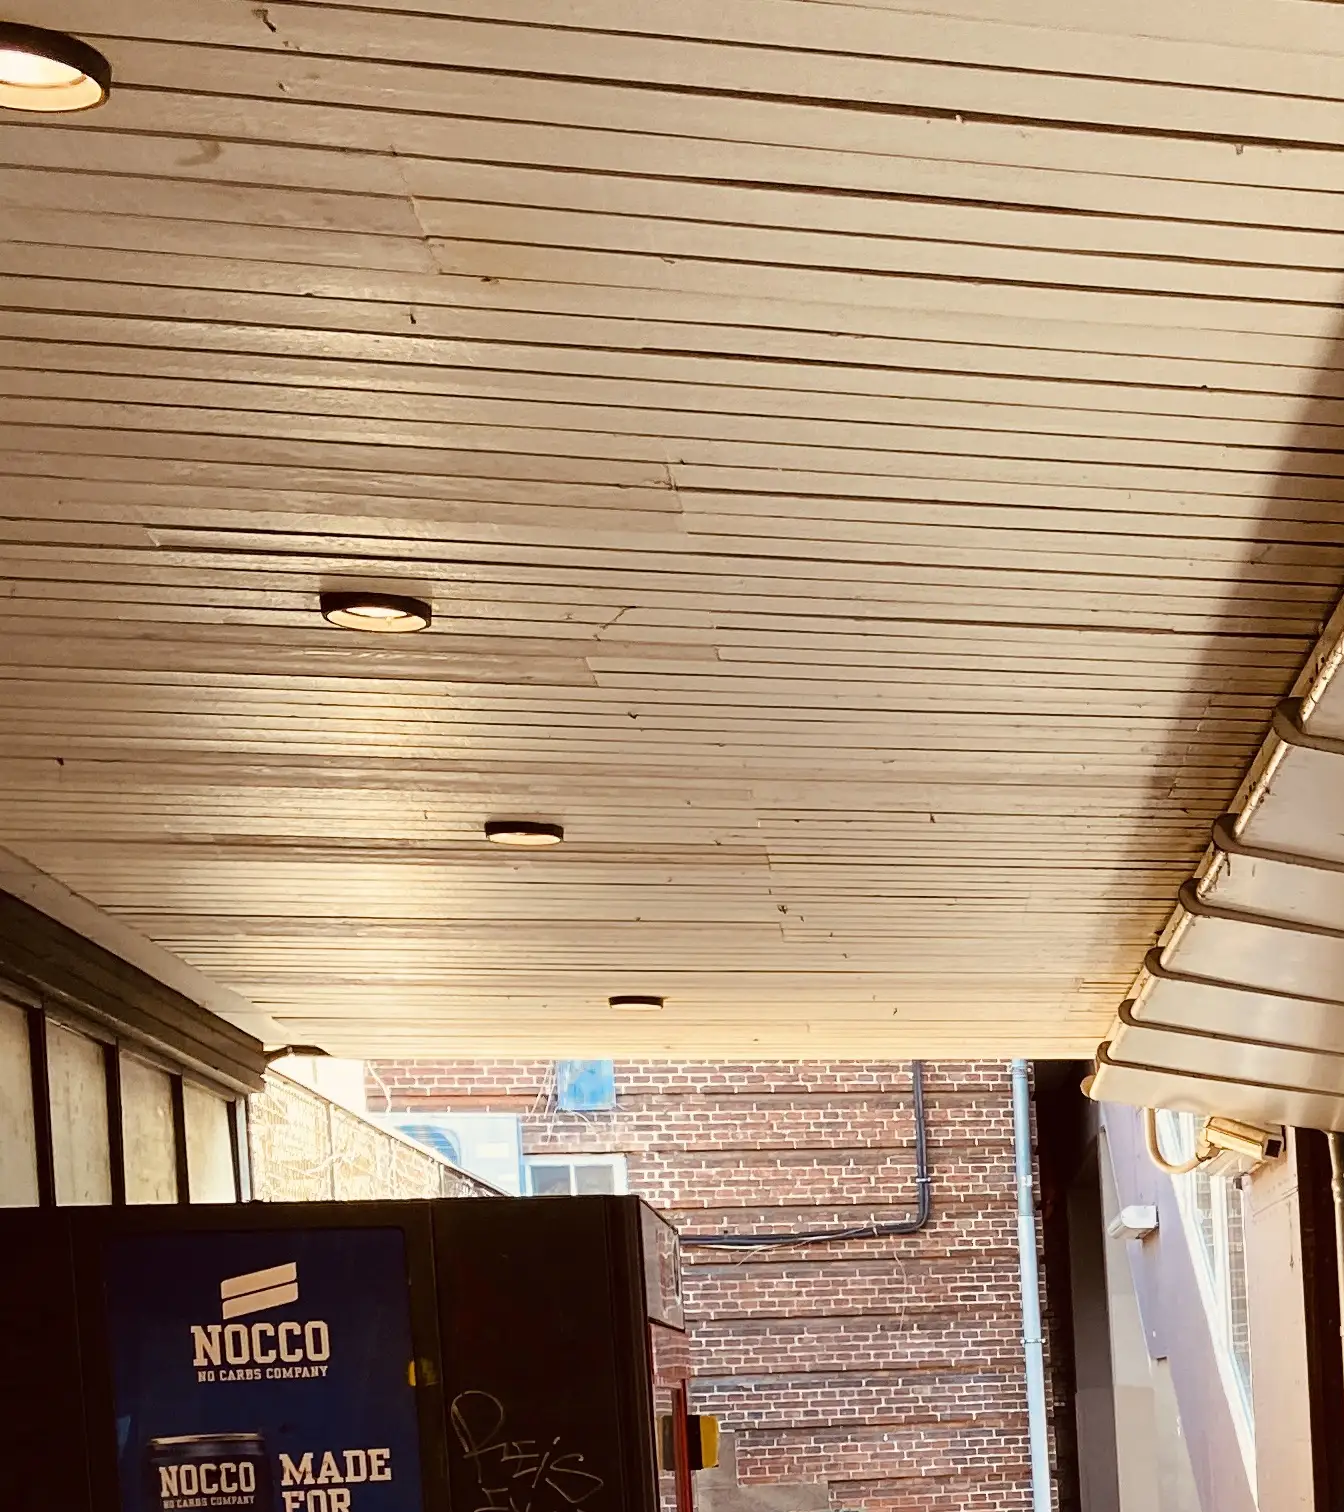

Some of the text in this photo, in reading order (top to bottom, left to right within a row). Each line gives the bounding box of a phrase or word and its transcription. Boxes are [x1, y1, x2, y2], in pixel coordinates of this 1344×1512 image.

[190, 1321, 330, 1366] NOCCO
[198, 1366, 329, 1382] NO CARBS COMPANY
[159, 1462, 256, 1497] NOCCO
[279, 1448, 392, 1486] MADE
